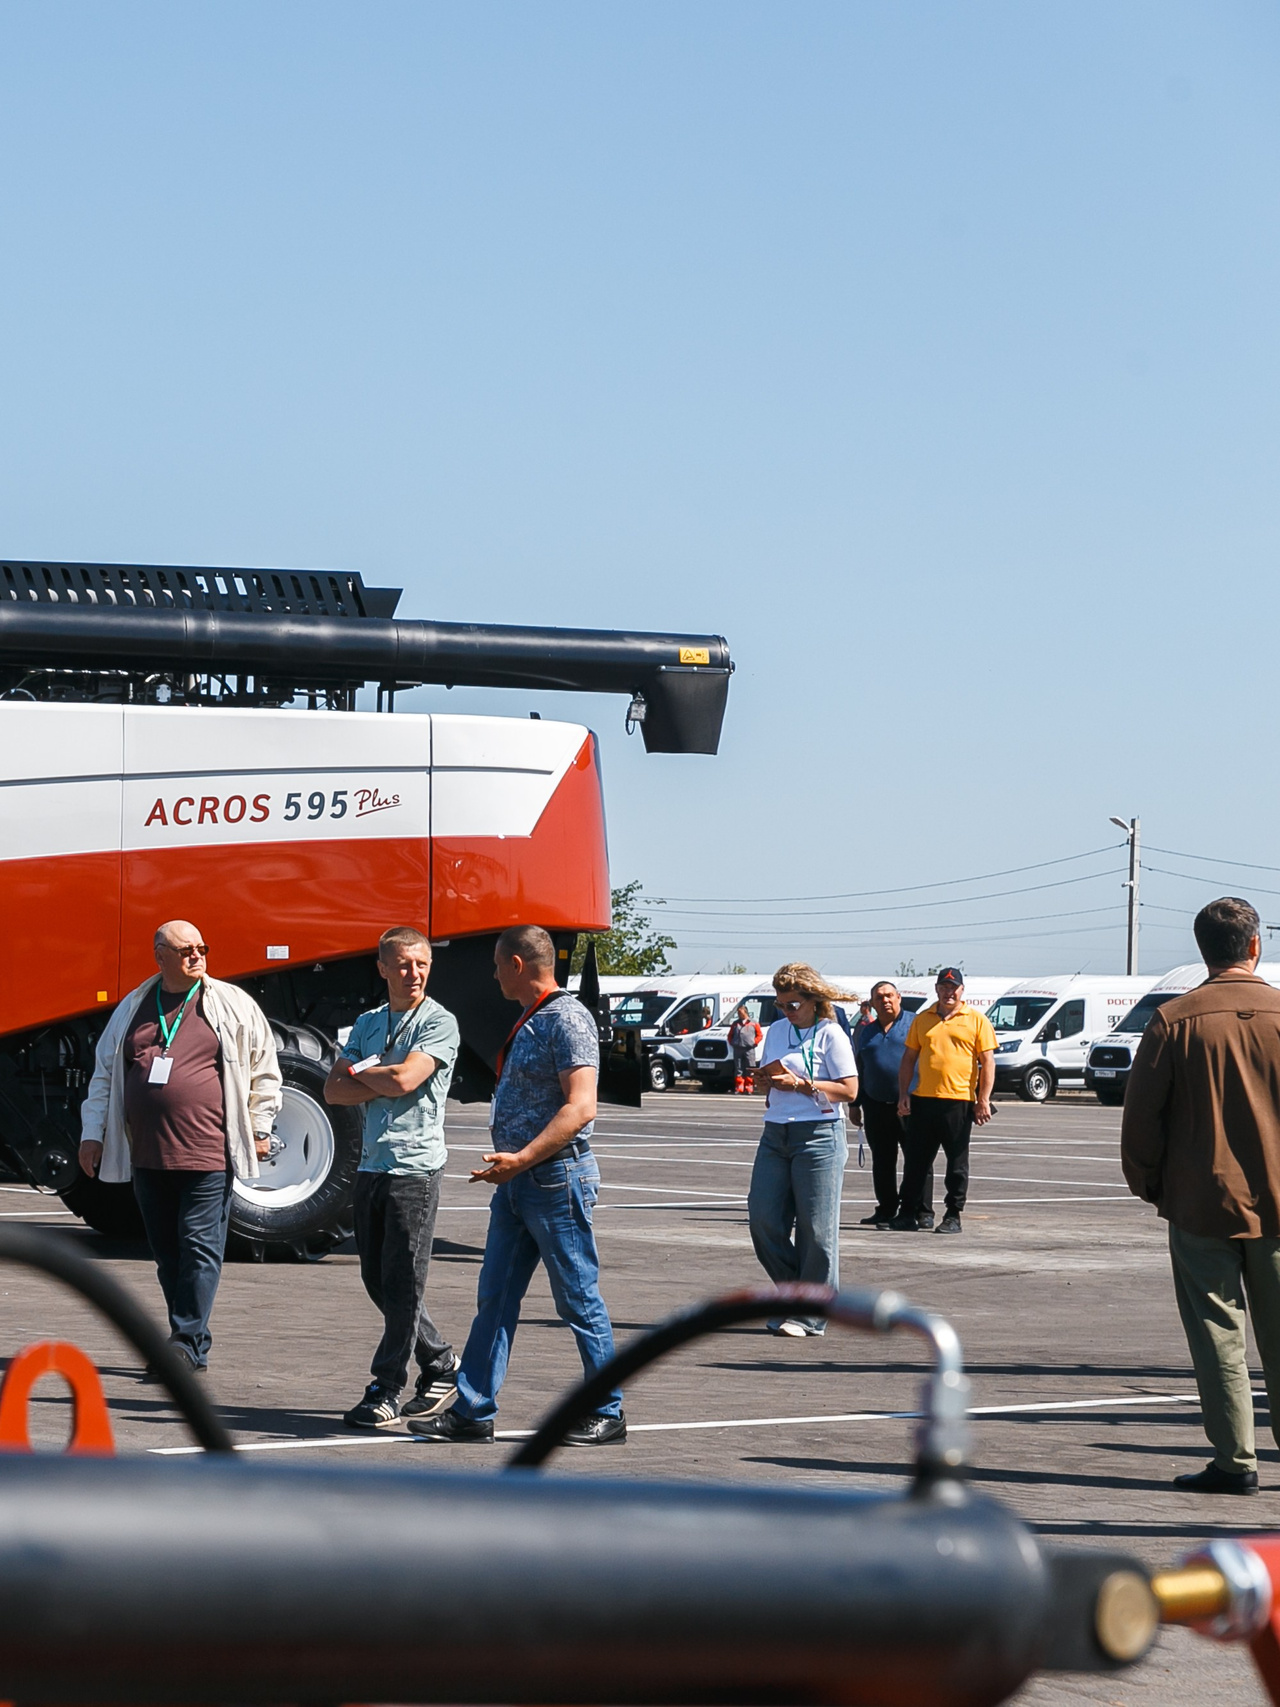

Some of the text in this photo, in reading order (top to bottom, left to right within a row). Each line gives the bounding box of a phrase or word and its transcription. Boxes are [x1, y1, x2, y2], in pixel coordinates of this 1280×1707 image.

[144, 788, 403, 827] ACROS 595 Plus
